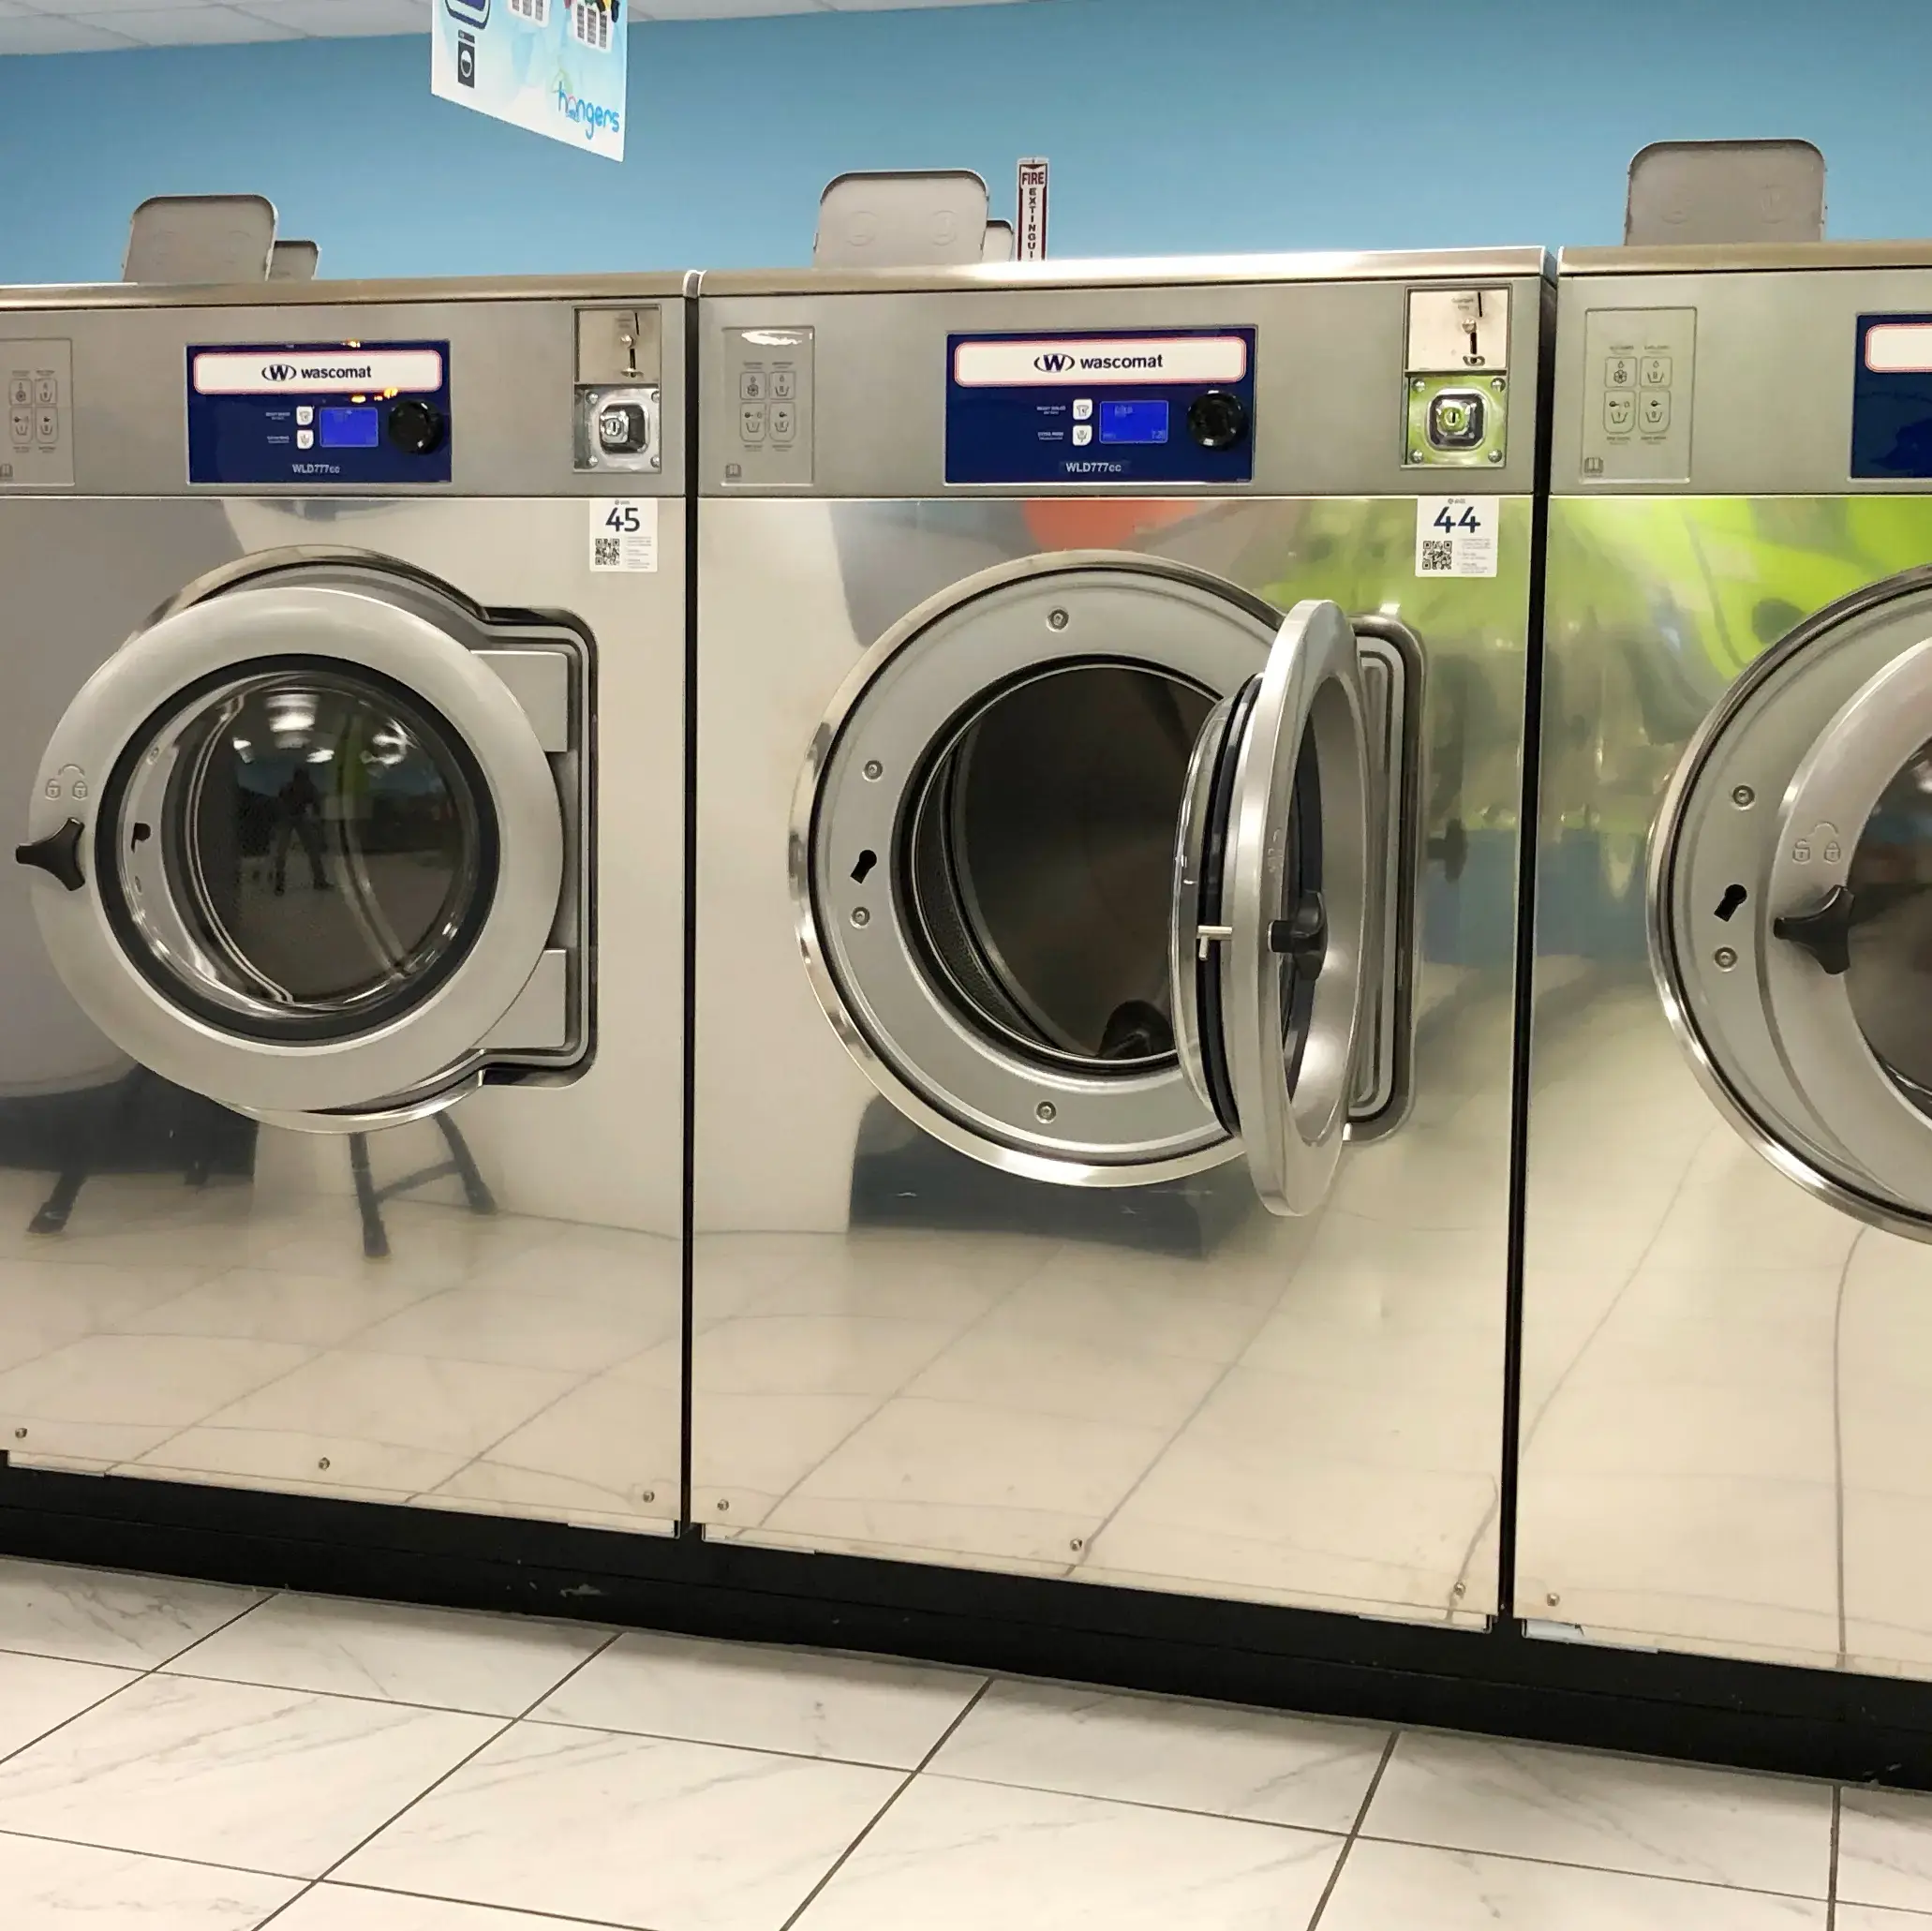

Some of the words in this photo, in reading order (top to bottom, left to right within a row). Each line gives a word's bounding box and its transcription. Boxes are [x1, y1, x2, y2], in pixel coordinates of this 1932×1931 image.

[557, 81, 620, 140] hangers
[1021, 171, 1045, 186] FIRE
[1079, 354, 1163, 369] wascomat
[301, 365, 372, 379] wascomat
[1065, 462, 1122, 473] WLD777cc
[604, 507, 641, 532] 45
[1433, 506, 1481, 533] 44
